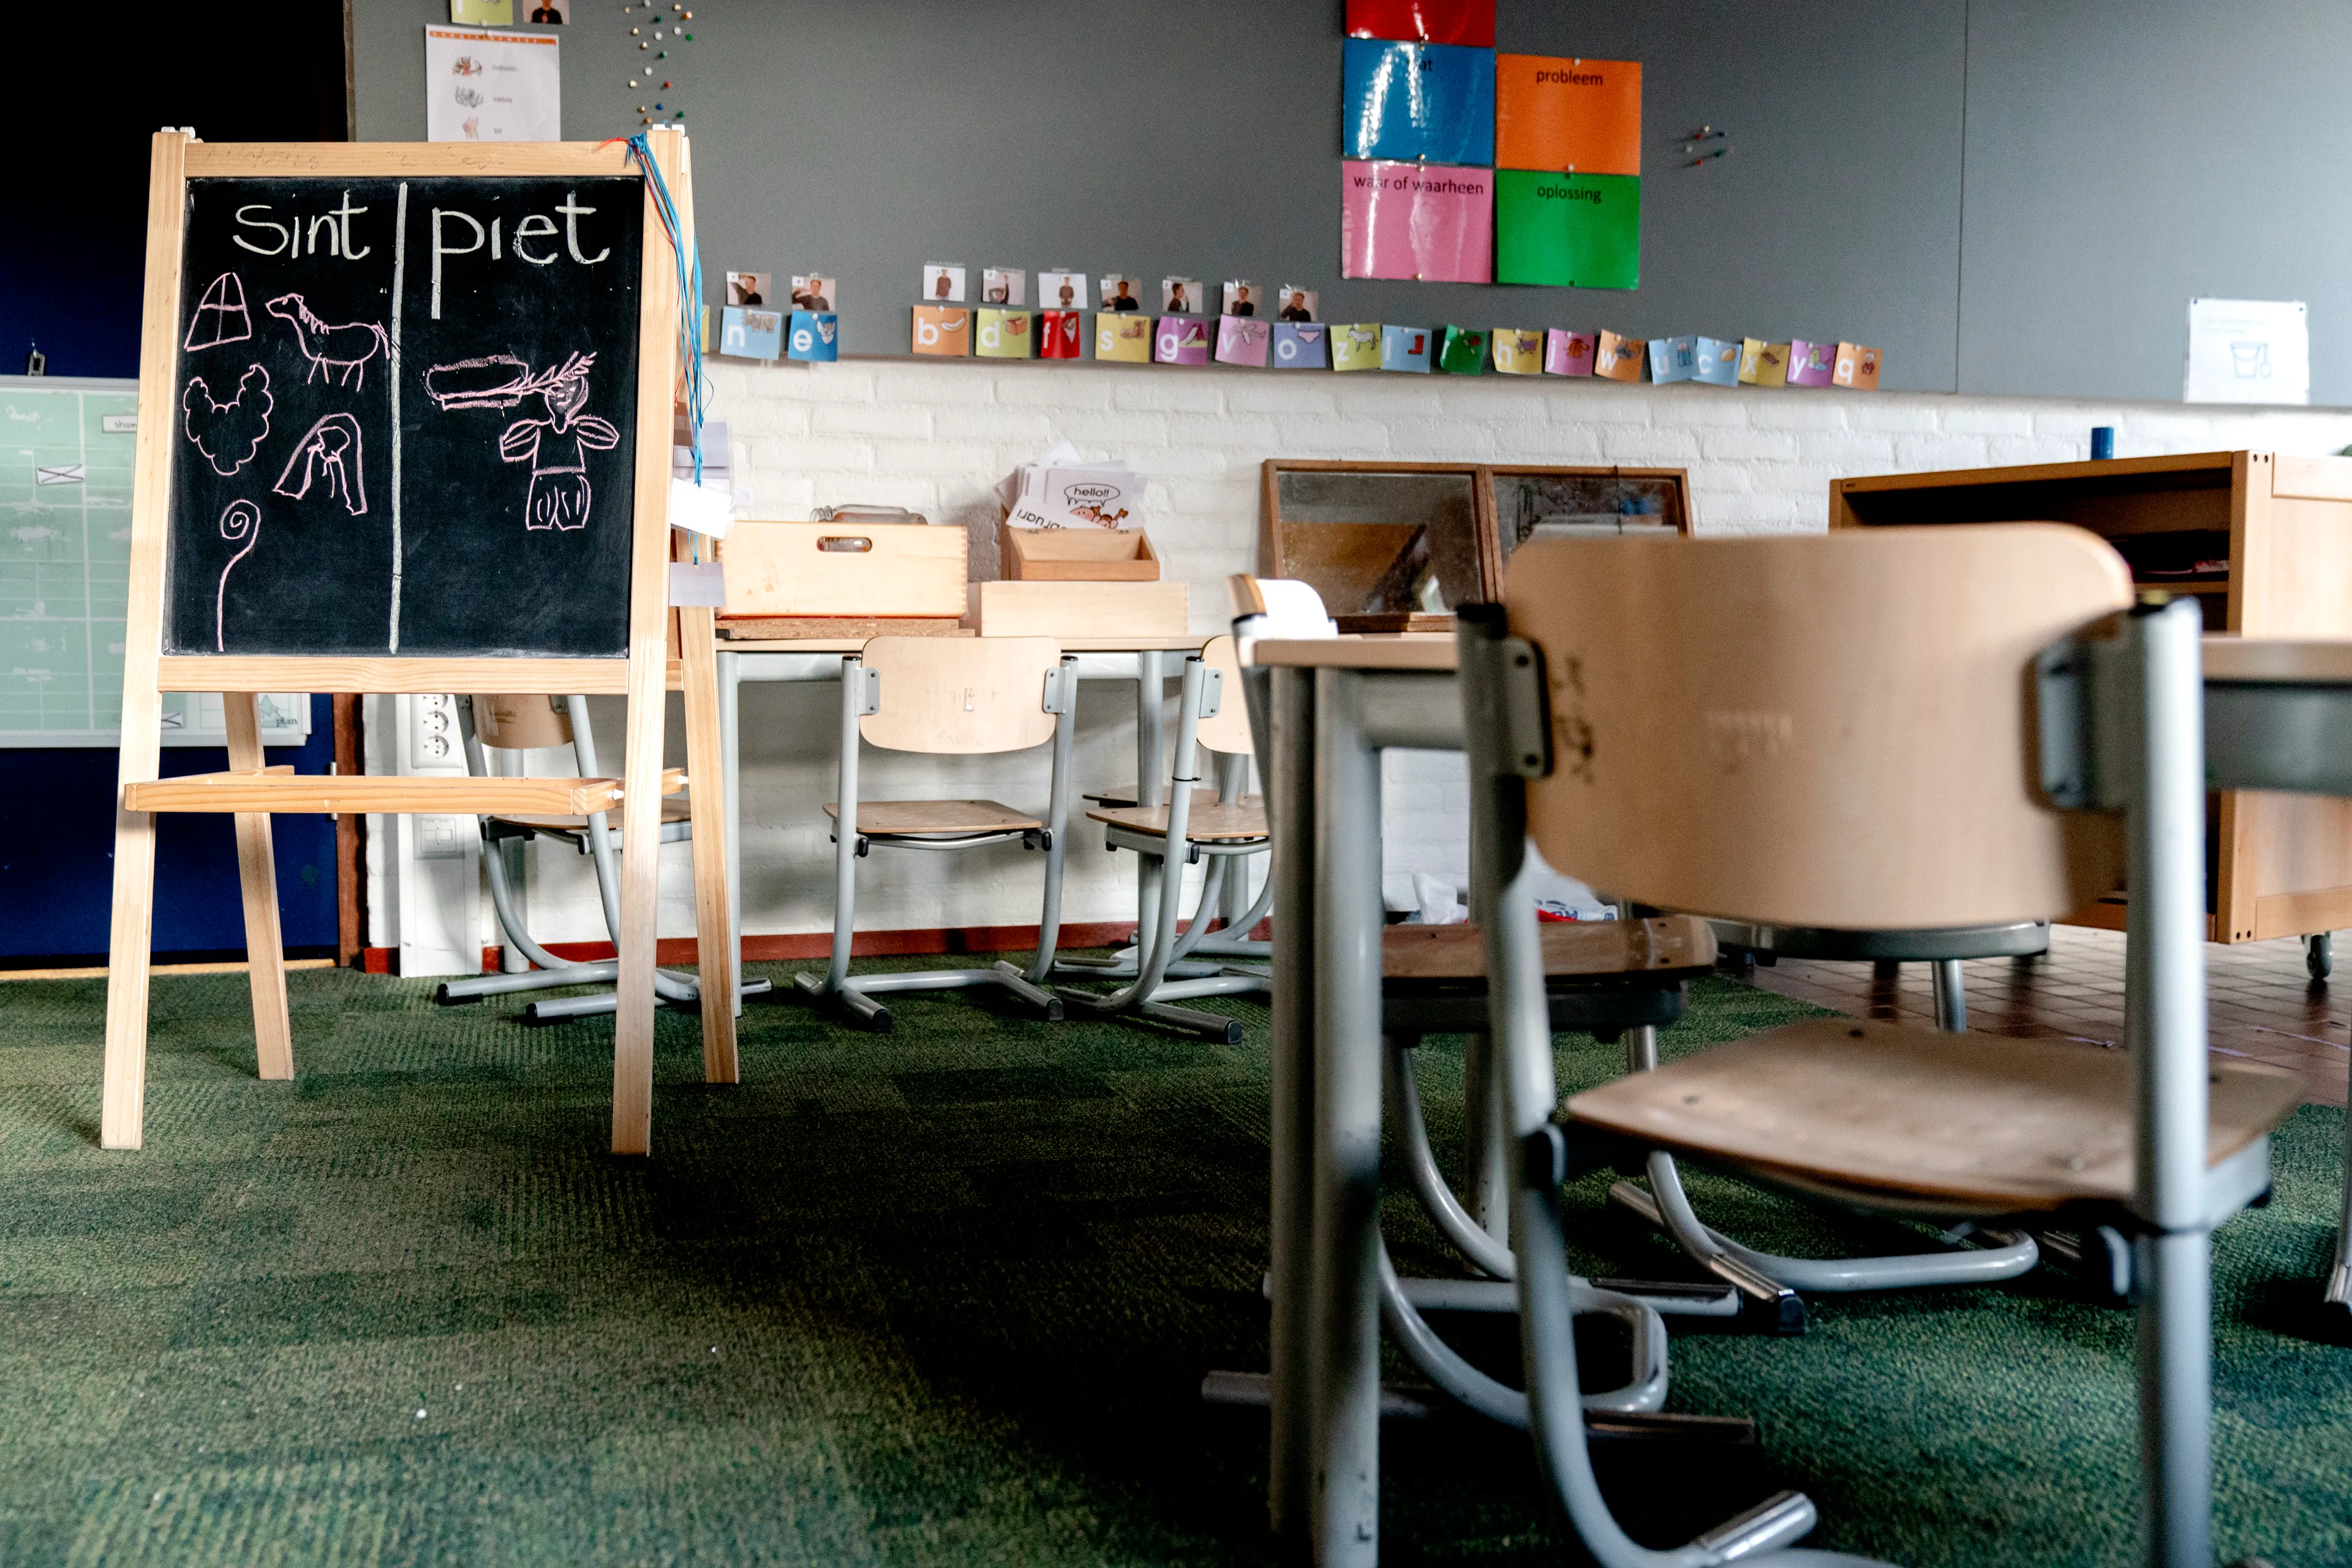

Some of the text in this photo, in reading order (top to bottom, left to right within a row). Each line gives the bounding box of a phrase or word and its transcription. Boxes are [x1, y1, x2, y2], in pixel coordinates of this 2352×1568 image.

[1536, 68, 1604, 86] probleem
[1354, 176, 1484, 195] waar of waarheen
[1536, 185, 1602, 204] oplossing
[431, 190, 611, 320] piet
[726, 325, 746, 347] n
[793, 328, 813, 352] e
[918, 317, 939, 345] b
[980, 321, 1000, 348] d
[1043, 321, 1051, 349] f
[1099, 330, 1114, 352] s
[1159, 333, 1179, 362] g
[1221, 332, 1237, 353] v
[1277, 339, 1297, 360] o
[1335, 341, 1349, 362] z
[1497, 339, 1512, 366] h
[1547, 340, 1557, 370] j
[1600, 348, 1619, 371] w
[1653, 355, 1670, 376] u
[1698, 354, 1713, 375] c
[1743, 353, 1759, 375] x
[1792, 355, 1807, 381] y
[1838, 358, 1855, 384] q
[1074, 487, 1109, 498] hello!!
